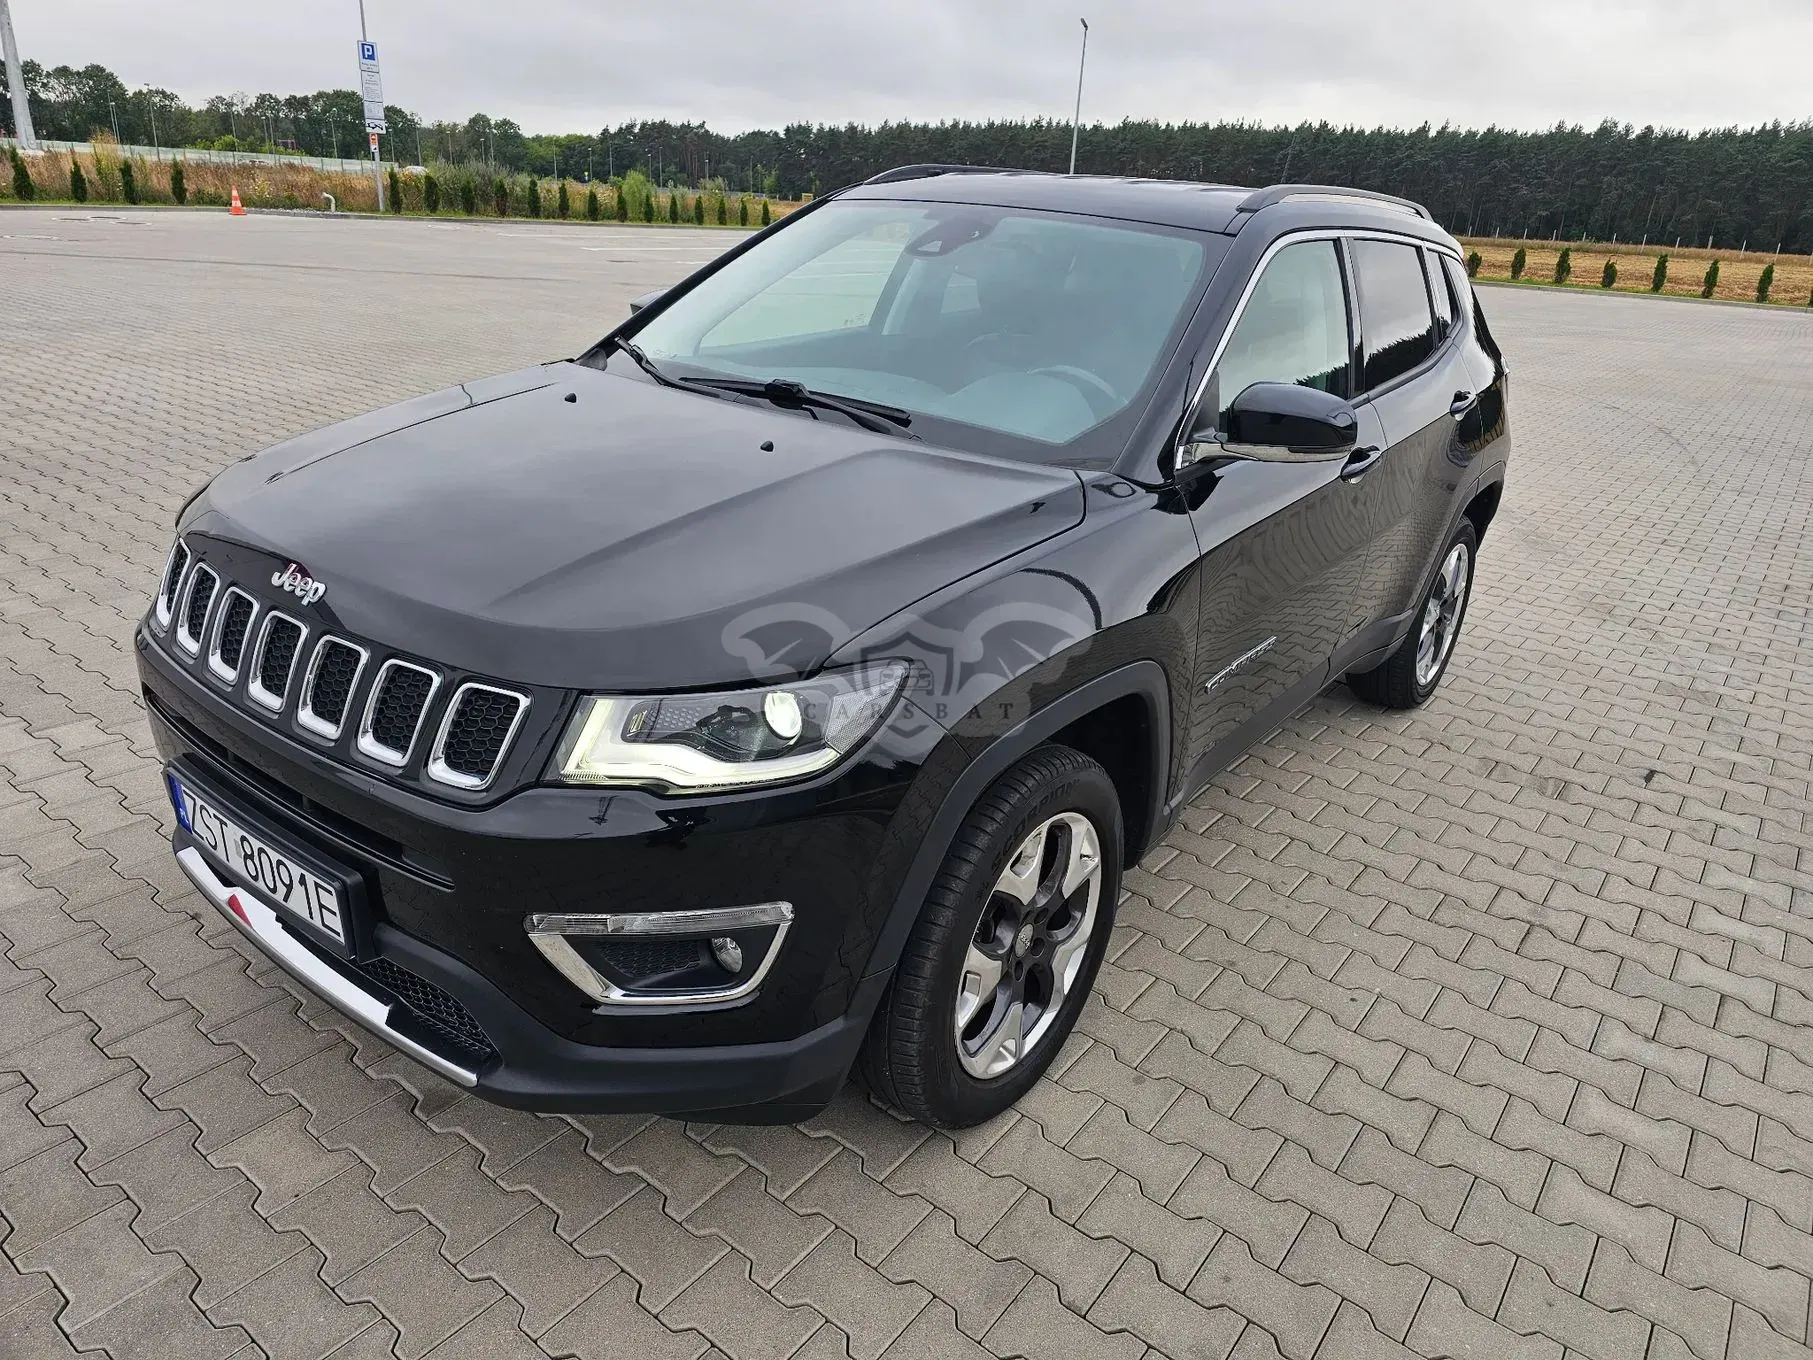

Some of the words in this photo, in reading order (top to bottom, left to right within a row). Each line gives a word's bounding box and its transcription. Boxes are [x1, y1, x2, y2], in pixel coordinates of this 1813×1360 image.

[271, 563, 327, 606] Jeep
[182, 789, 229, 862] ZST
[240, 834, 342, 938] 8091E
